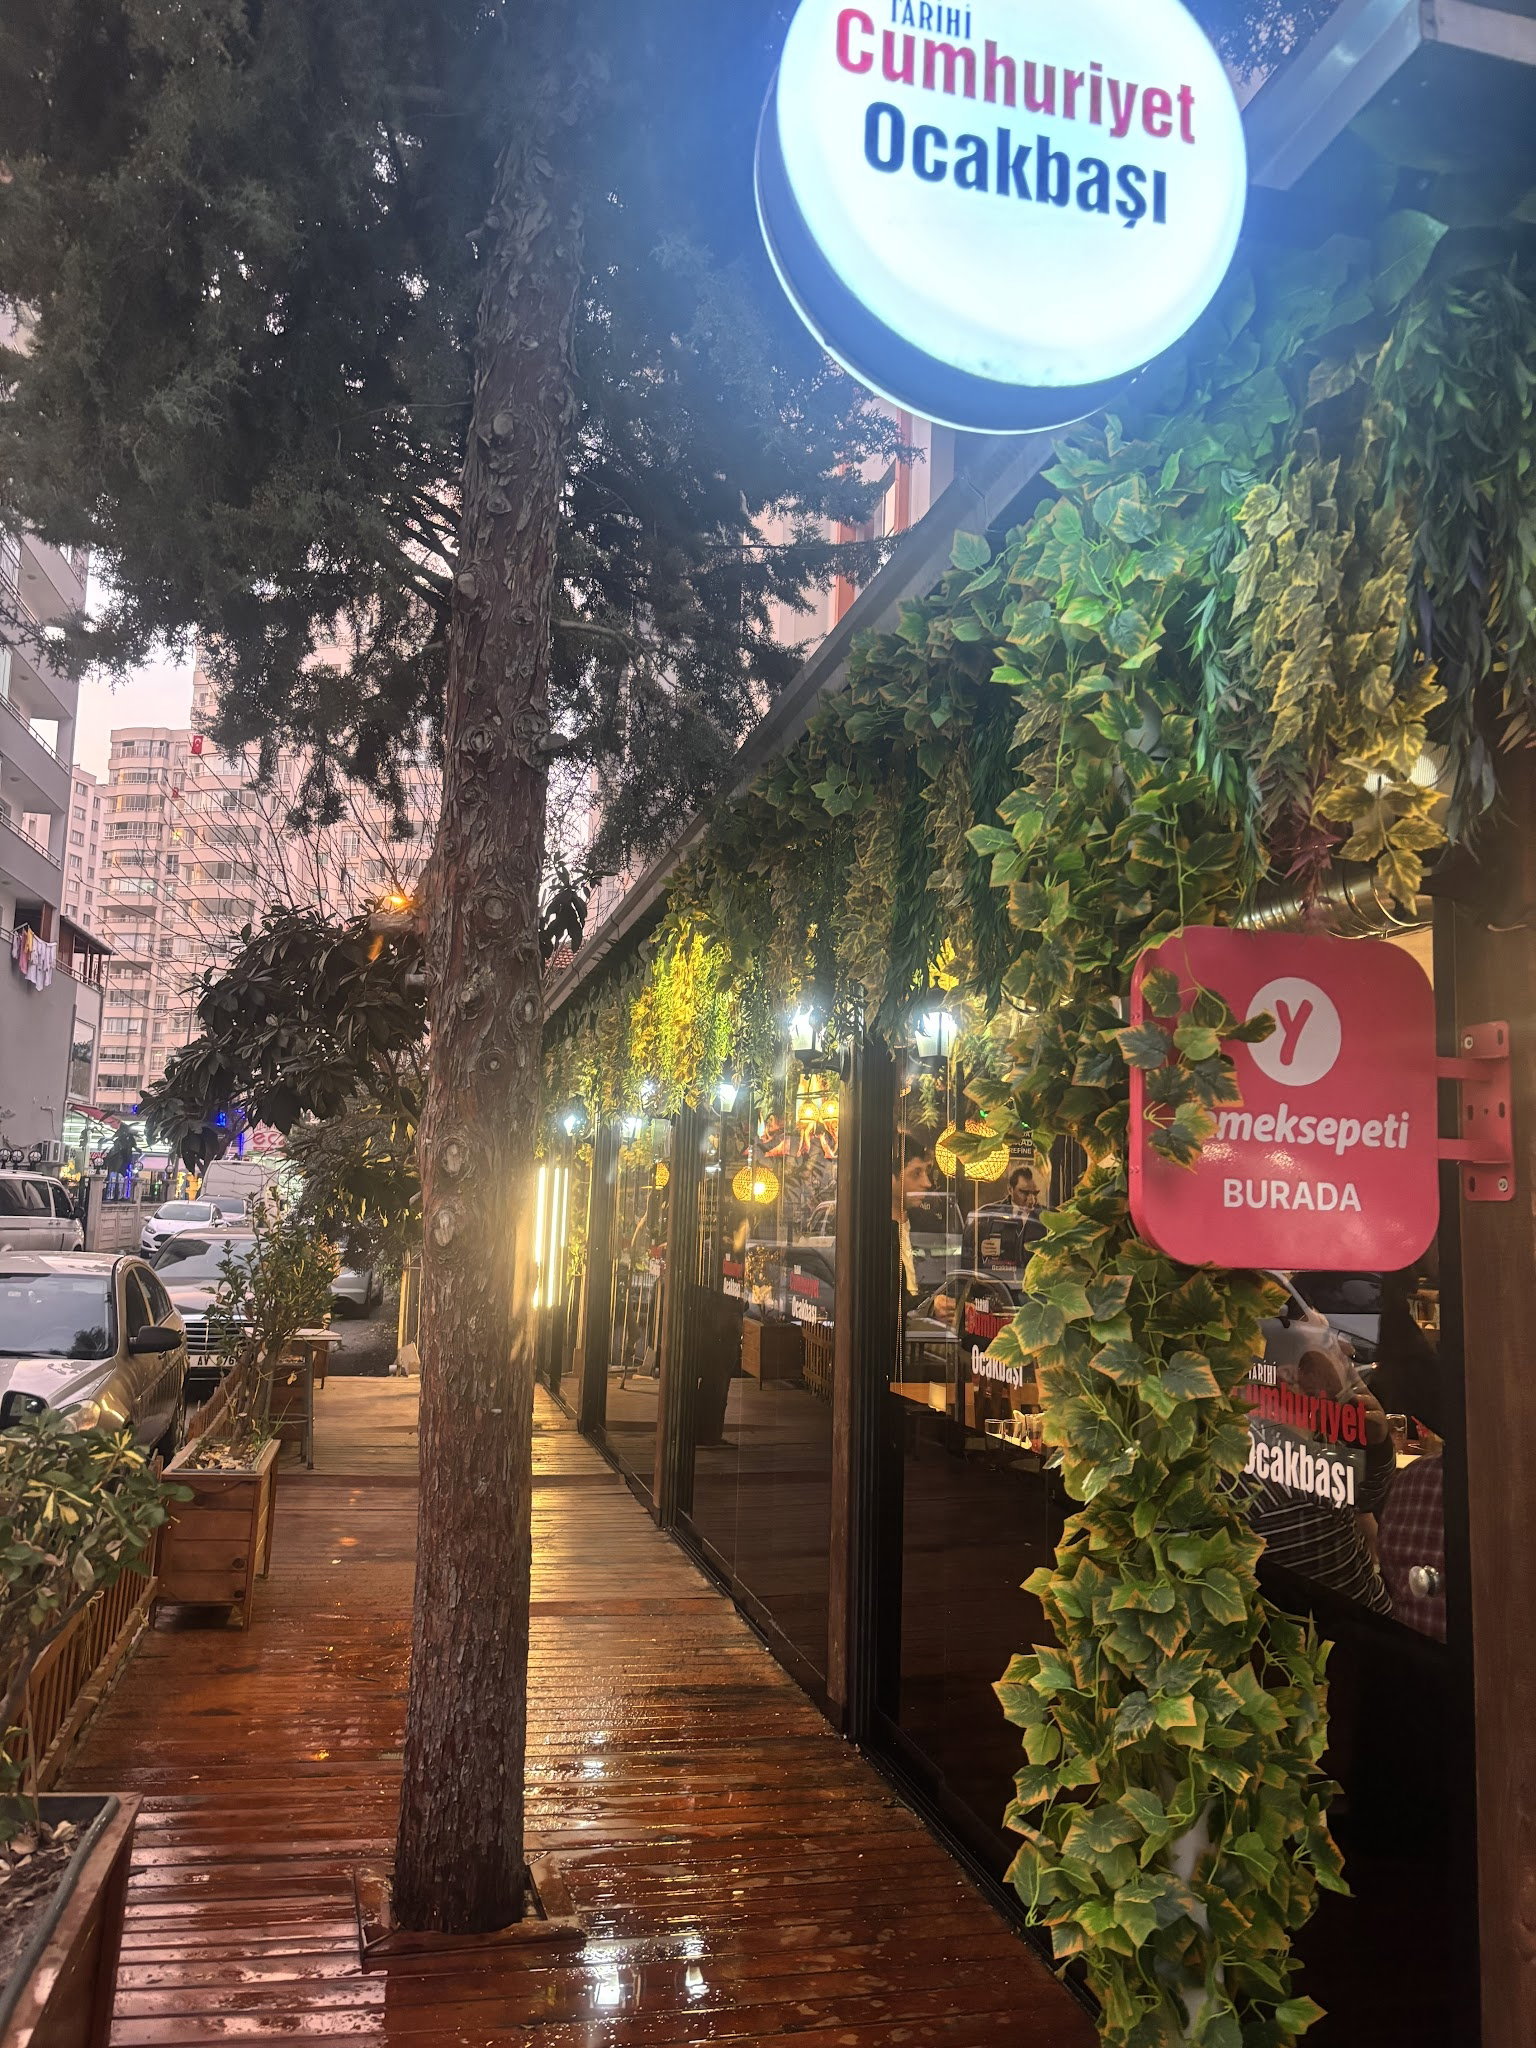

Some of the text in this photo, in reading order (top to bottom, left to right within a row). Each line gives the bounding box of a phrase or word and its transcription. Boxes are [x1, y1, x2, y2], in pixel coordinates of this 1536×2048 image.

[891, 0, 971, 39] TARİHİ
[836, 8, 1196, 144] Cumhuriyet
[864, 101, 1167, 229] Ocakbaşı
[1223, 1178, 1362, 1212] BURADA
